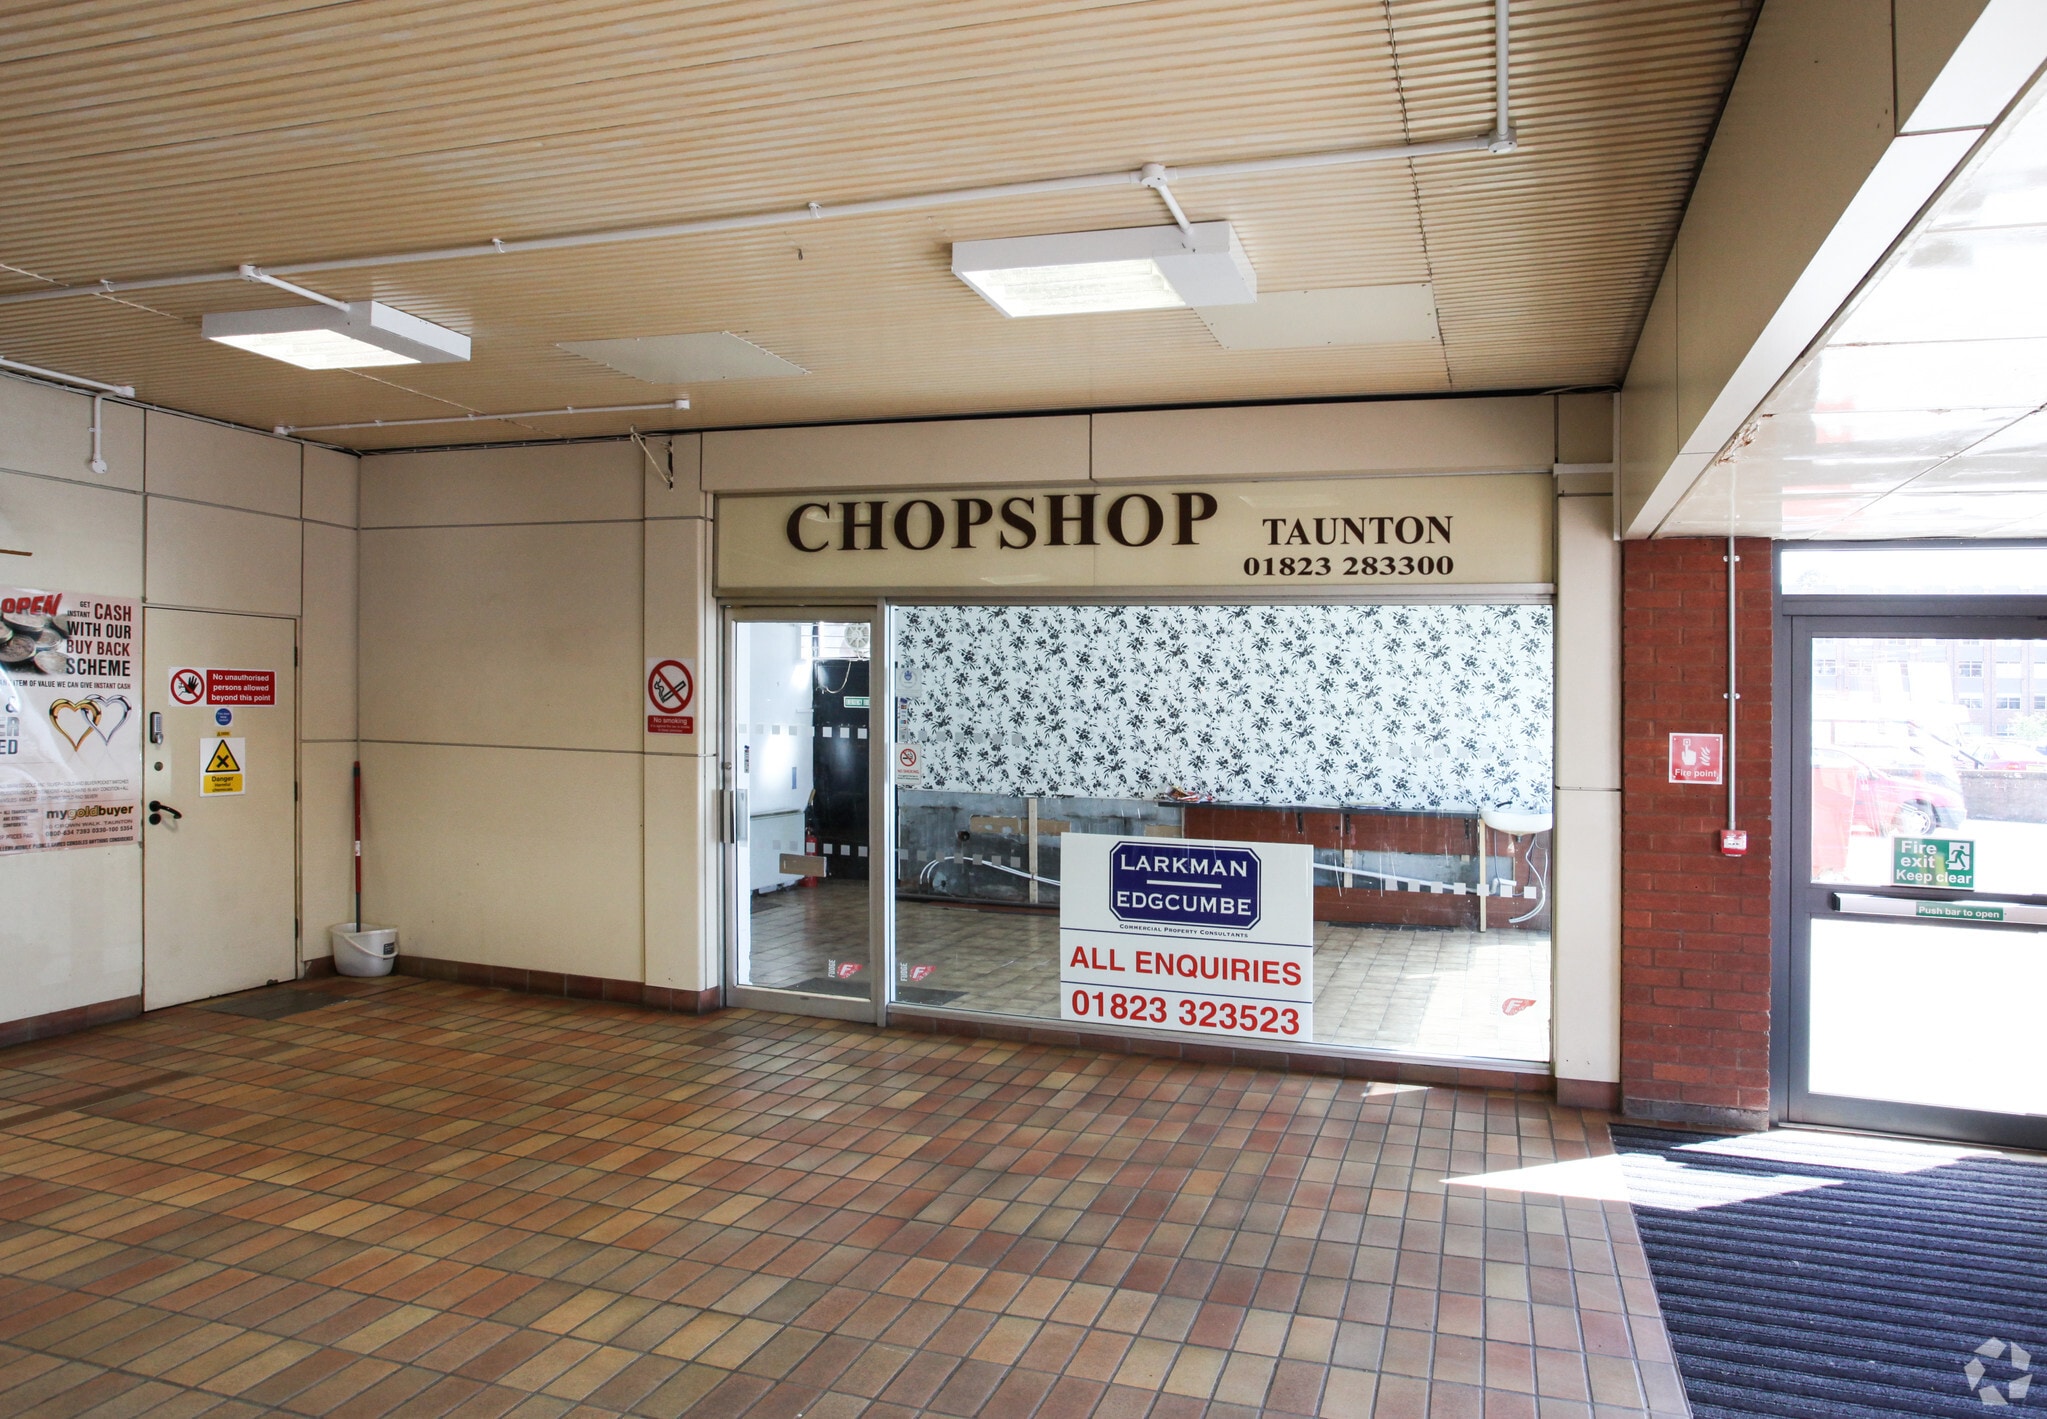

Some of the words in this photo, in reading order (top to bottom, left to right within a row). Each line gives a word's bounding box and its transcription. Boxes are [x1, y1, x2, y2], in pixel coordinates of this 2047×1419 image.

[786, 491, 1219, 553] CHOPSHOP
[1262, 515, 1454, 546] TAUNTON
[1243, 555, 1333, 577] 01823
[1342, 555, 1455, 577] 283300
[1, 593, 62, 616] OPEN
[94, 602, 132, 622] CASH
[67, 610, 90, 618] INSTANT
[67, 621, 101, 637] WITH
[106, 624, 131, 639] OUR
[66, 639, 92, 655] BUY
[97, 641, 130, 657] BACK
[66, 657, 131, 677] SCHEME
[38, 680, 56, 688] VALUE
[67, 681, 79, 689] CAN
[94, 682, 116, 690] INSTANT
[212, 673, 223, 681] No
[224, 674, 270, 682] unauthorised
[211, 694, 238, 702] beyond
[254, 694, 271, 702] point
[663, 718, 688, 726] smoking
[1694, 769, 1717, 778] point
[46, 804, 134, 820] mygoldbuyer
[1901, 840, 1937, 855] Fire
[1120, 854, 1248, 878] LARKMAN
[1901, 855, 1935, 868] exit
[1896, 869, 1932, 883] Keep
[1936, 872, 1972, 884] clear
[1116, 890, 1252, 916] EDGCUMBE
[1919, 906, 1943, 915] Push
[1945, 907, 1961, 915] bar
[1963, 908, 1973, 916] to
[1975, 910, 2000, 919] open
[900, 962, 908, 981] FUDGE
[1070, 946, 1126, 972] ALL
[1135, 950, 1302, 986] ENQUIRIES
[1071, 989, 1168, 1023] 01823
[1178, 999, 1300, 1035] 323523
